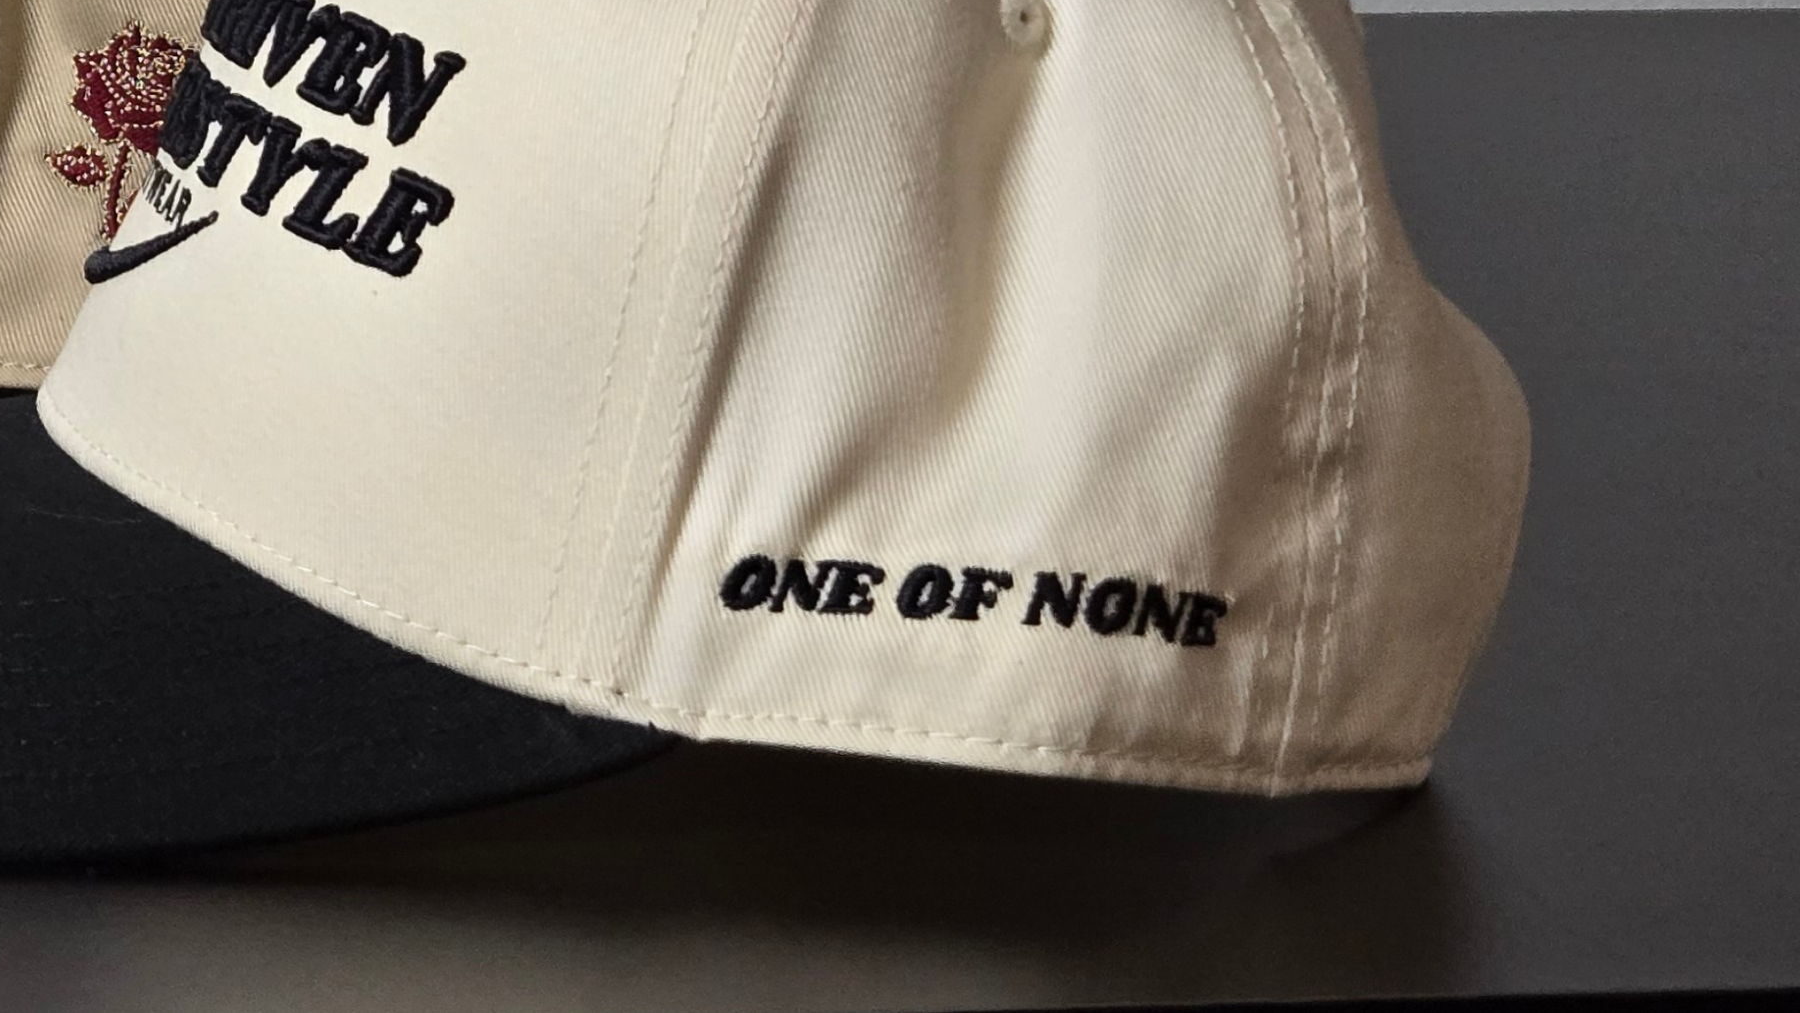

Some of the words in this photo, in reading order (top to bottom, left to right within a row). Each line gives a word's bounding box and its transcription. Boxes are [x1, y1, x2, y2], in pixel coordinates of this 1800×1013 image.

[719, 552, 885, 615] ONE
[896, 563, 1014, 621] OF
[1021, 569, 1229, 648] NONE
